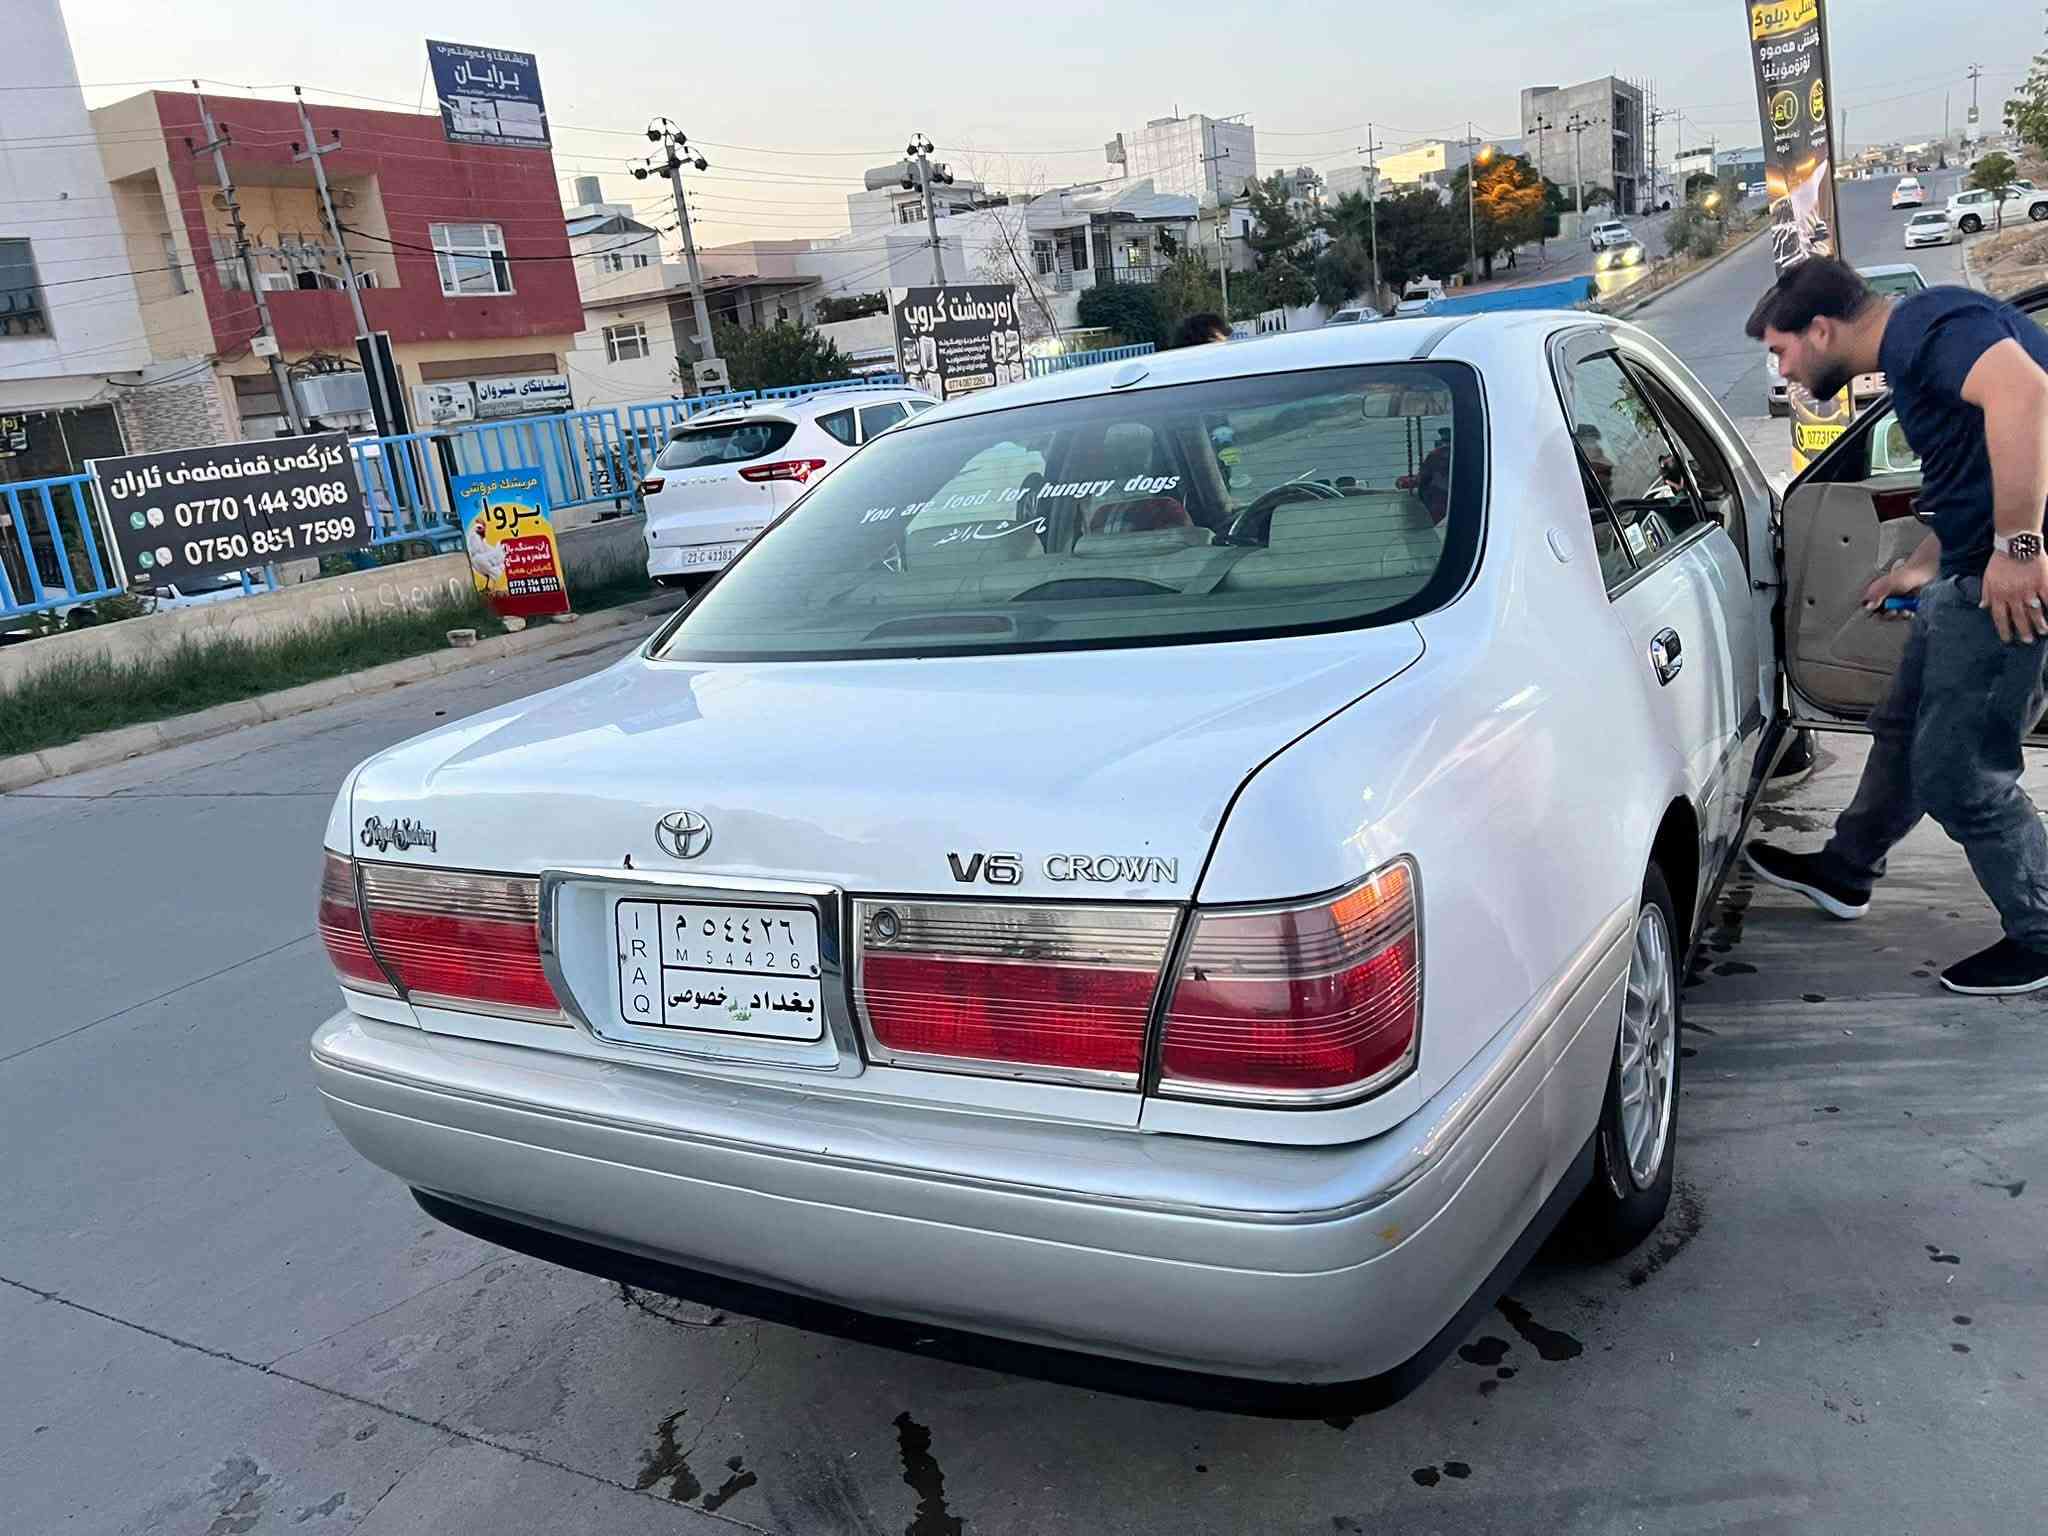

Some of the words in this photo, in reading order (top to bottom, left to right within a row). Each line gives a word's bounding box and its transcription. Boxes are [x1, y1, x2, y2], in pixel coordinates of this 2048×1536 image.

[174, 496, 239, 527] 0770
[243, 490, 288, 517] 144
[291, 481, 348, 509] 3068
[482, 497, 541, 537] بڕوا
[861, 506, 894, 524] You
[901, 500, 936, 517] are
[944, 491, 987, 511] food
[999, 486, 1029, 503] for
[1036, 478, 1115, 502] hungry
[1123, 473, 1180, 493] dogs
[184, 535, 249, 565] 0750
[252, 525, 295, 553] 851
[300, 516, 356, 546] 7599
[946, 850, 1023, 886] V6
[1042, 853, 1178, 884] CROWN
[631, 911, 650, 1014] IRAQ
[750, 991, 815, 1022] بغداد
